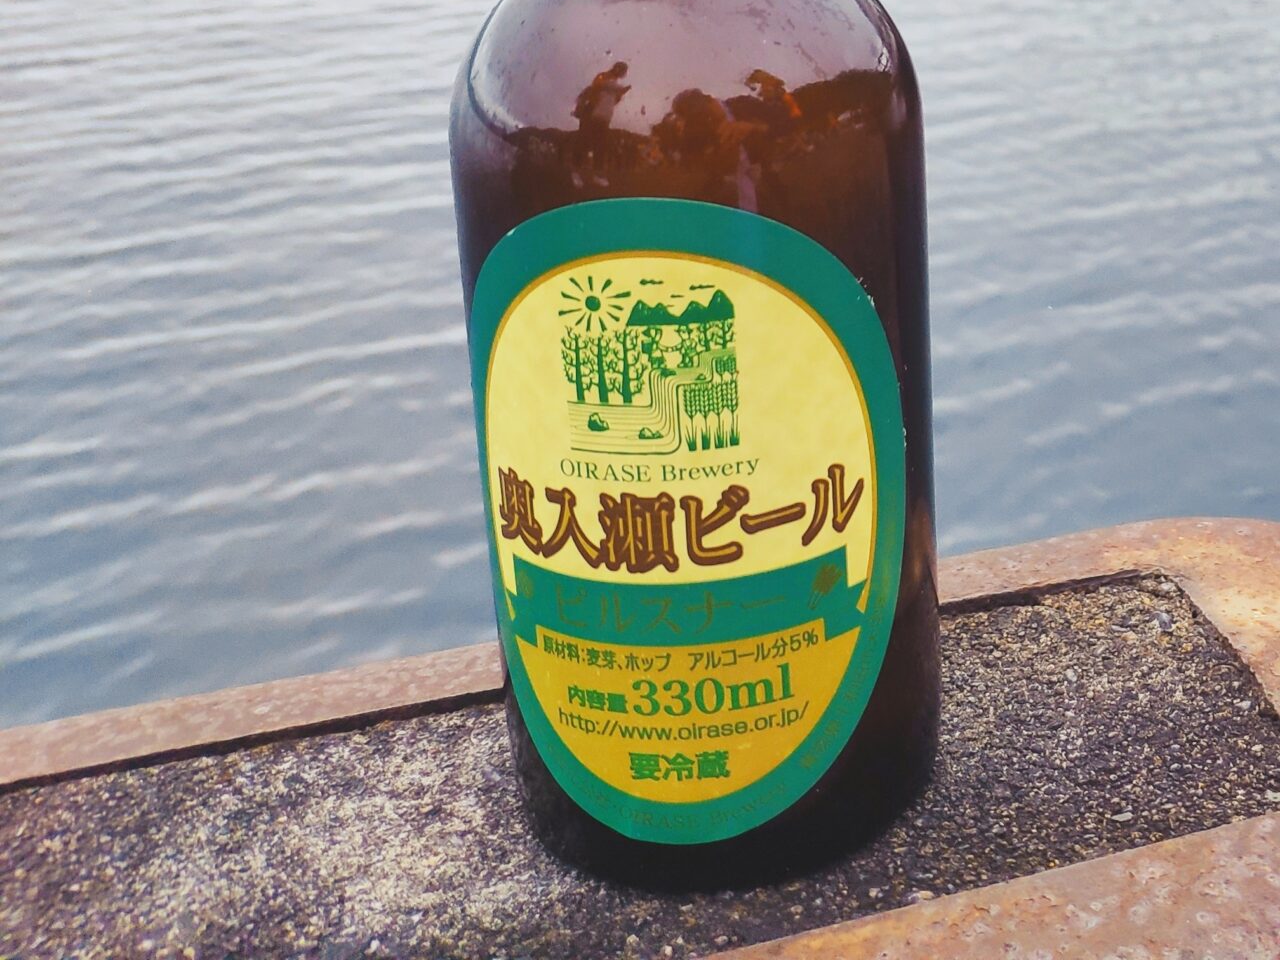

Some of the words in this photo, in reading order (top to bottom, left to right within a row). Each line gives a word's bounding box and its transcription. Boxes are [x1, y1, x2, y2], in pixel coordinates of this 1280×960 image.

[559, 458, 651, 483] OIRASE
[661, 458, 760, 482] Brewery
[498, 463, 865, 574] 奥入瀬ビール
[556, 588, 786, 635] ピルスナー
[558, 701, 810, 741] http://www.oirase.or.jp/
[628, 750, 731, 781] 要冷蔵
